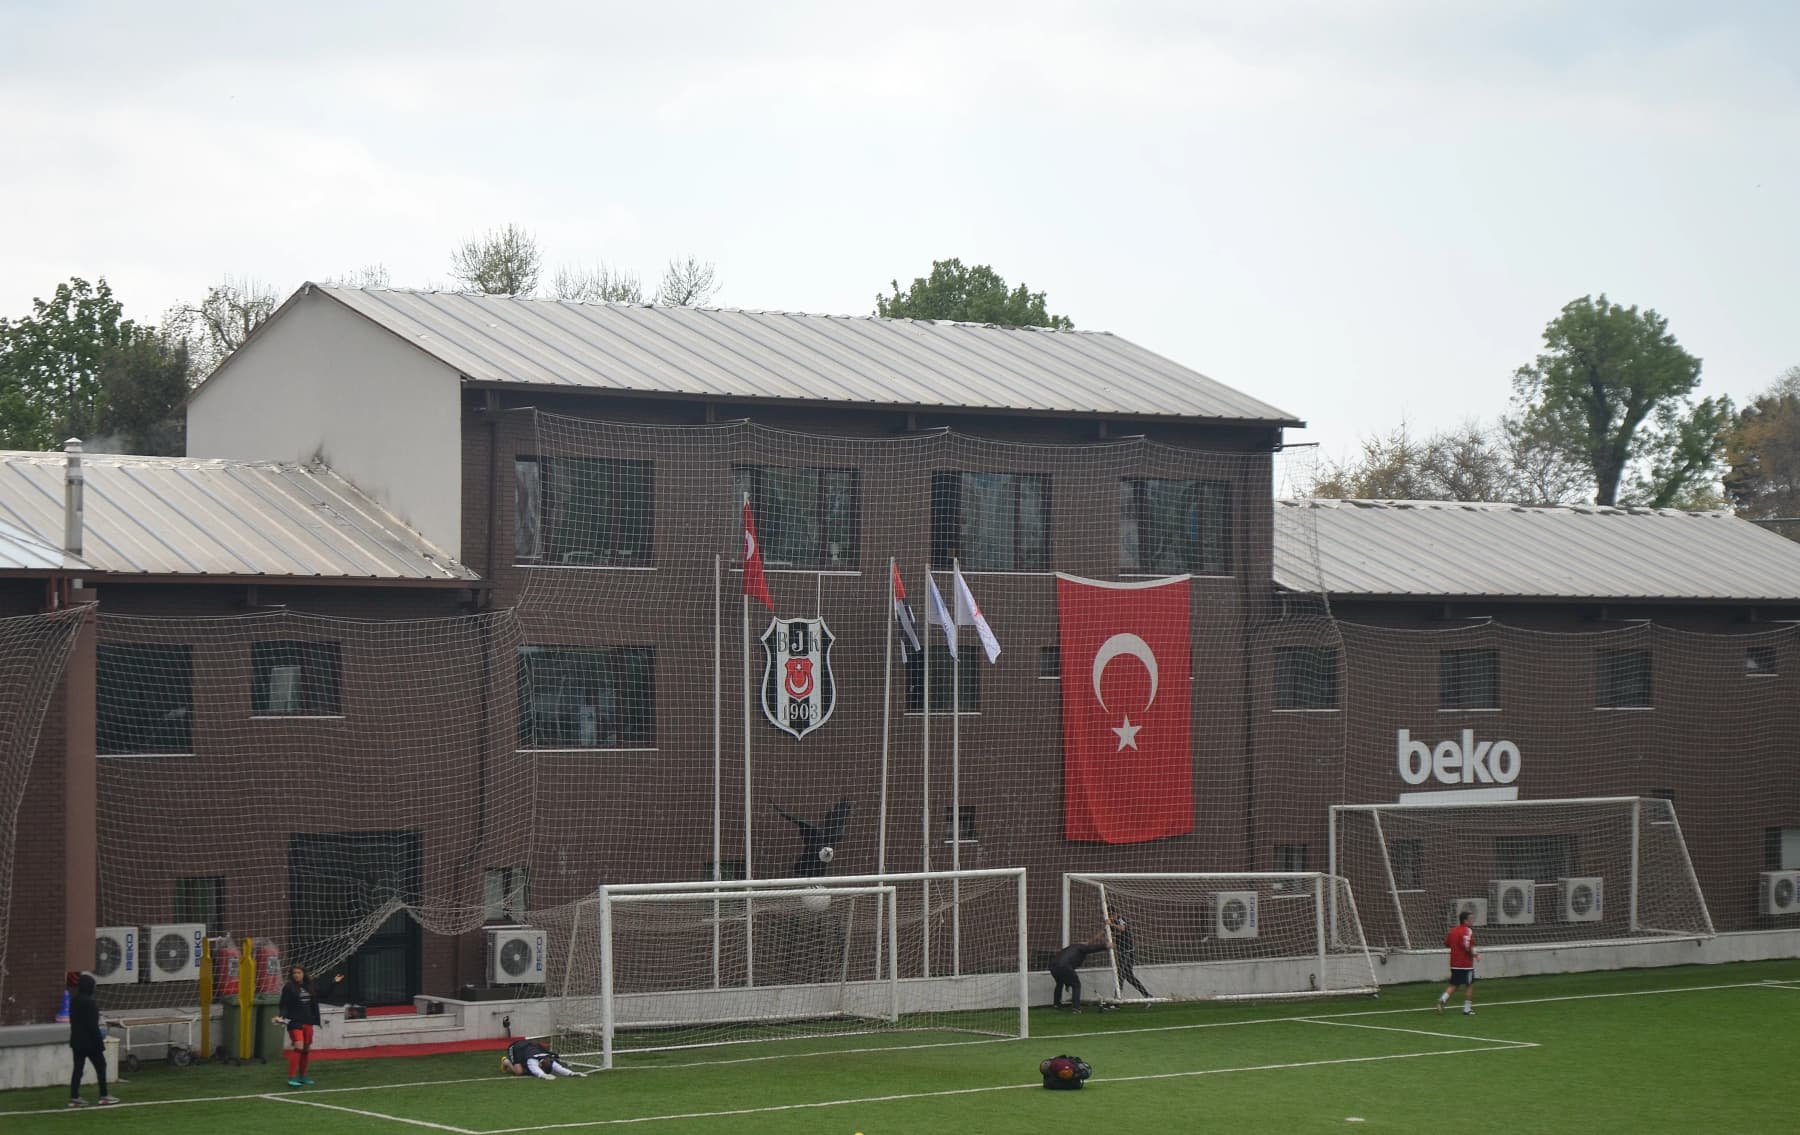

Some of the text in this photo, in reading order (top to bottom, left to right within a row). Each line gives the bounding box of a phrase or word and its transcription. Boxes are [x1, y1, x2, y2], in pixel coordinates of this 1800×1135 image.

[777, 630, 820, 653] BJK
[782, 703, 819, 720] 1903
[1397, 728, 1521, 785] beko
[126, 933, 134, 971] BEKO
